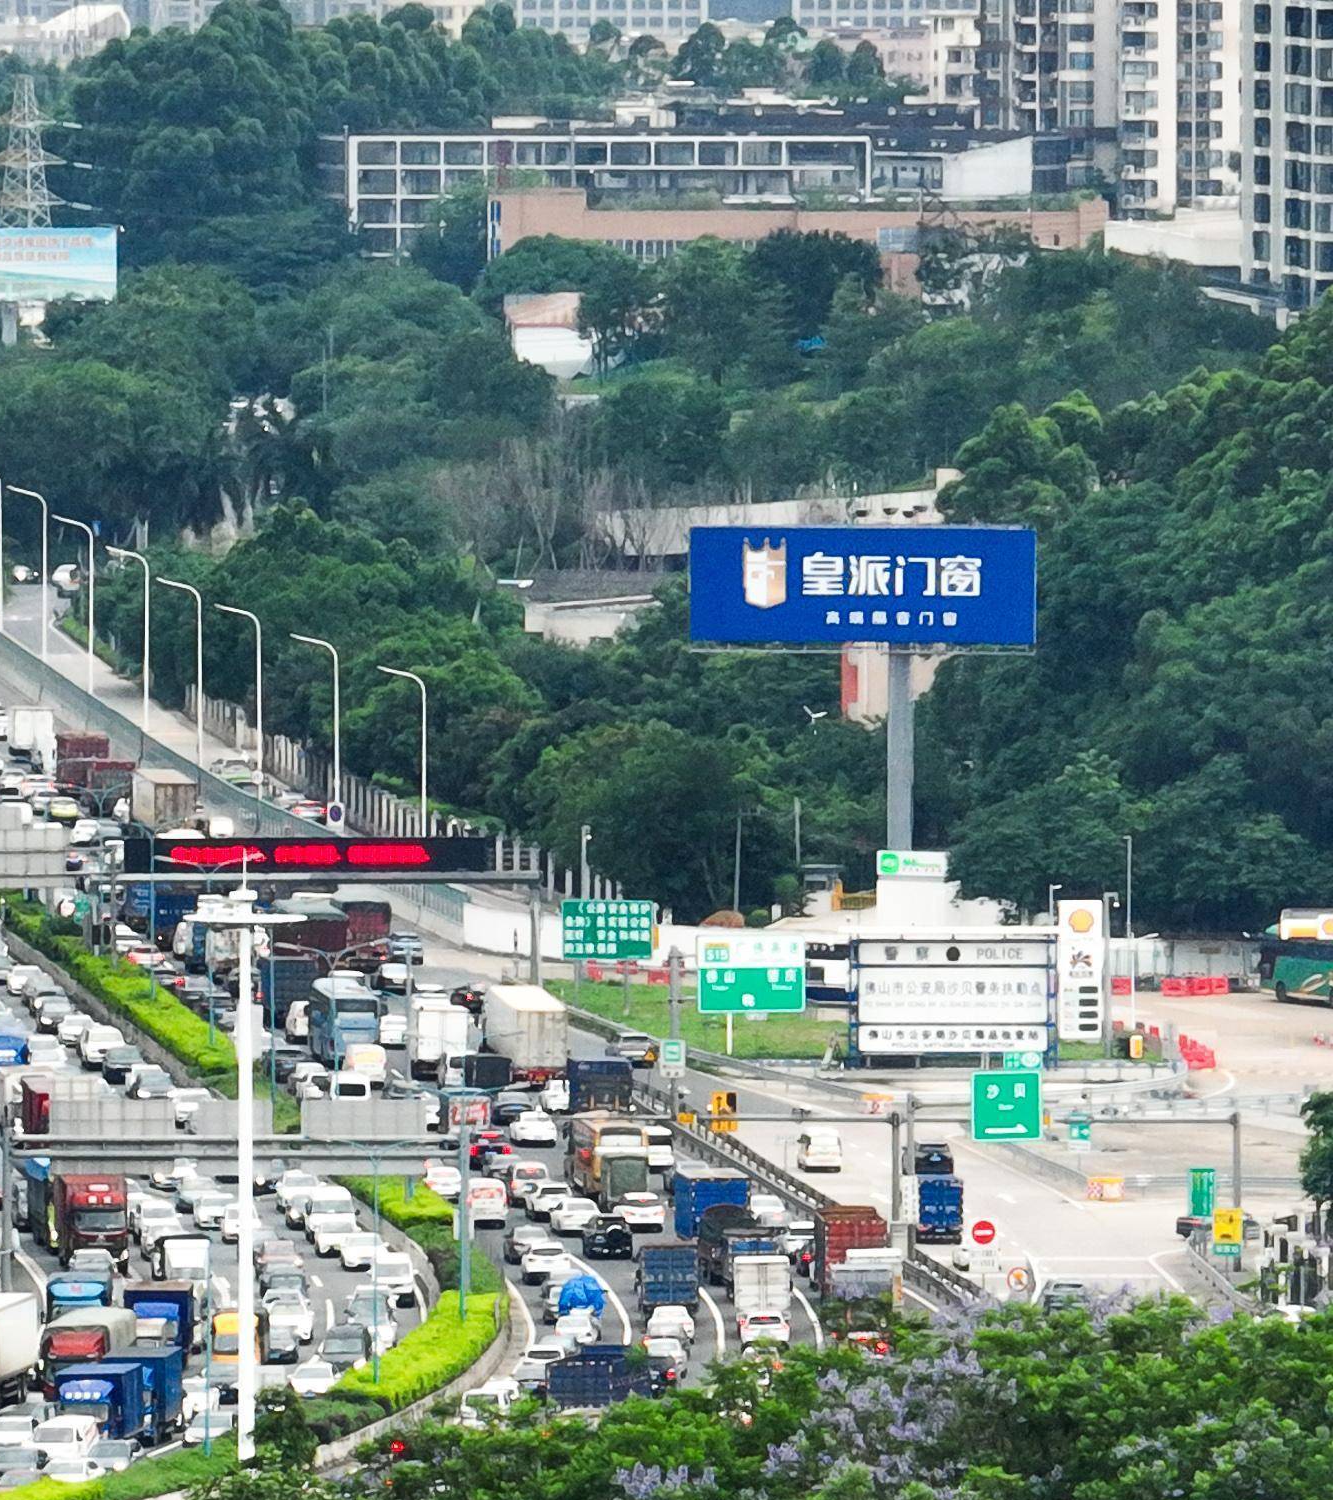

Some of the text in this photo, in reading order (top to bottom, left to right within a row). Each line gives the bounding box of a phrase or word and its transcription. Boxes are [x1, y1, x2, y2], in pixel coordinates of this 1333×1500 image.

[802, 551, 982, 597] 皇派门窗
[976, 947, 1024, 960] POLICE
